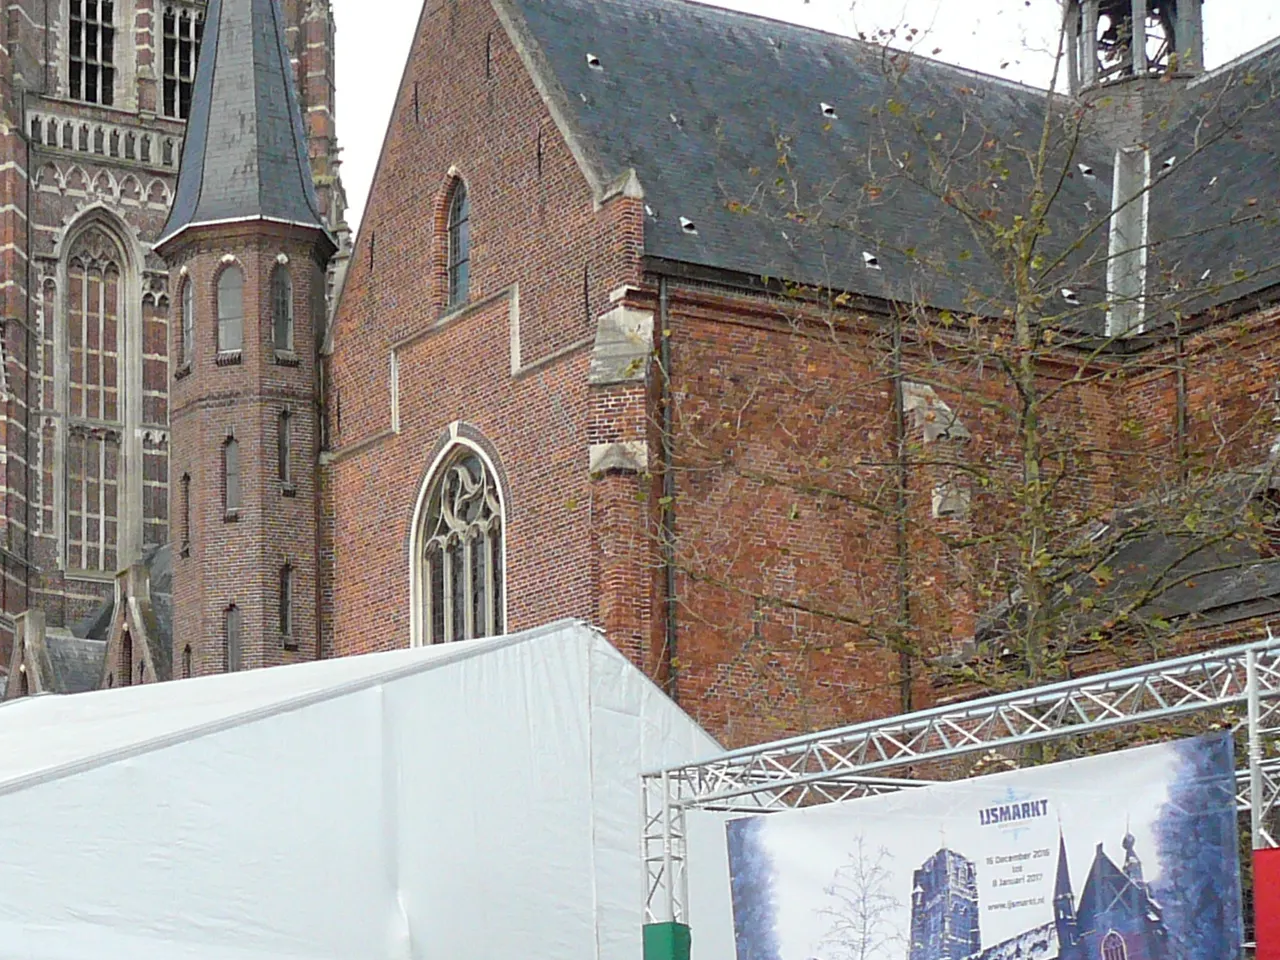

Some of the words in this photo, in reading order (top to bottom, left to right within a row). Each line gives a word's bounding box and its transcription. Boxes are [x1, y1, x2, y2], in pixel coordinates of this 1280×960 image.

[979, 799, 1048, 826] IJSMARKT
[995, 851, 1031, 864] December
[1033, 848, 1051, 859] 2016
